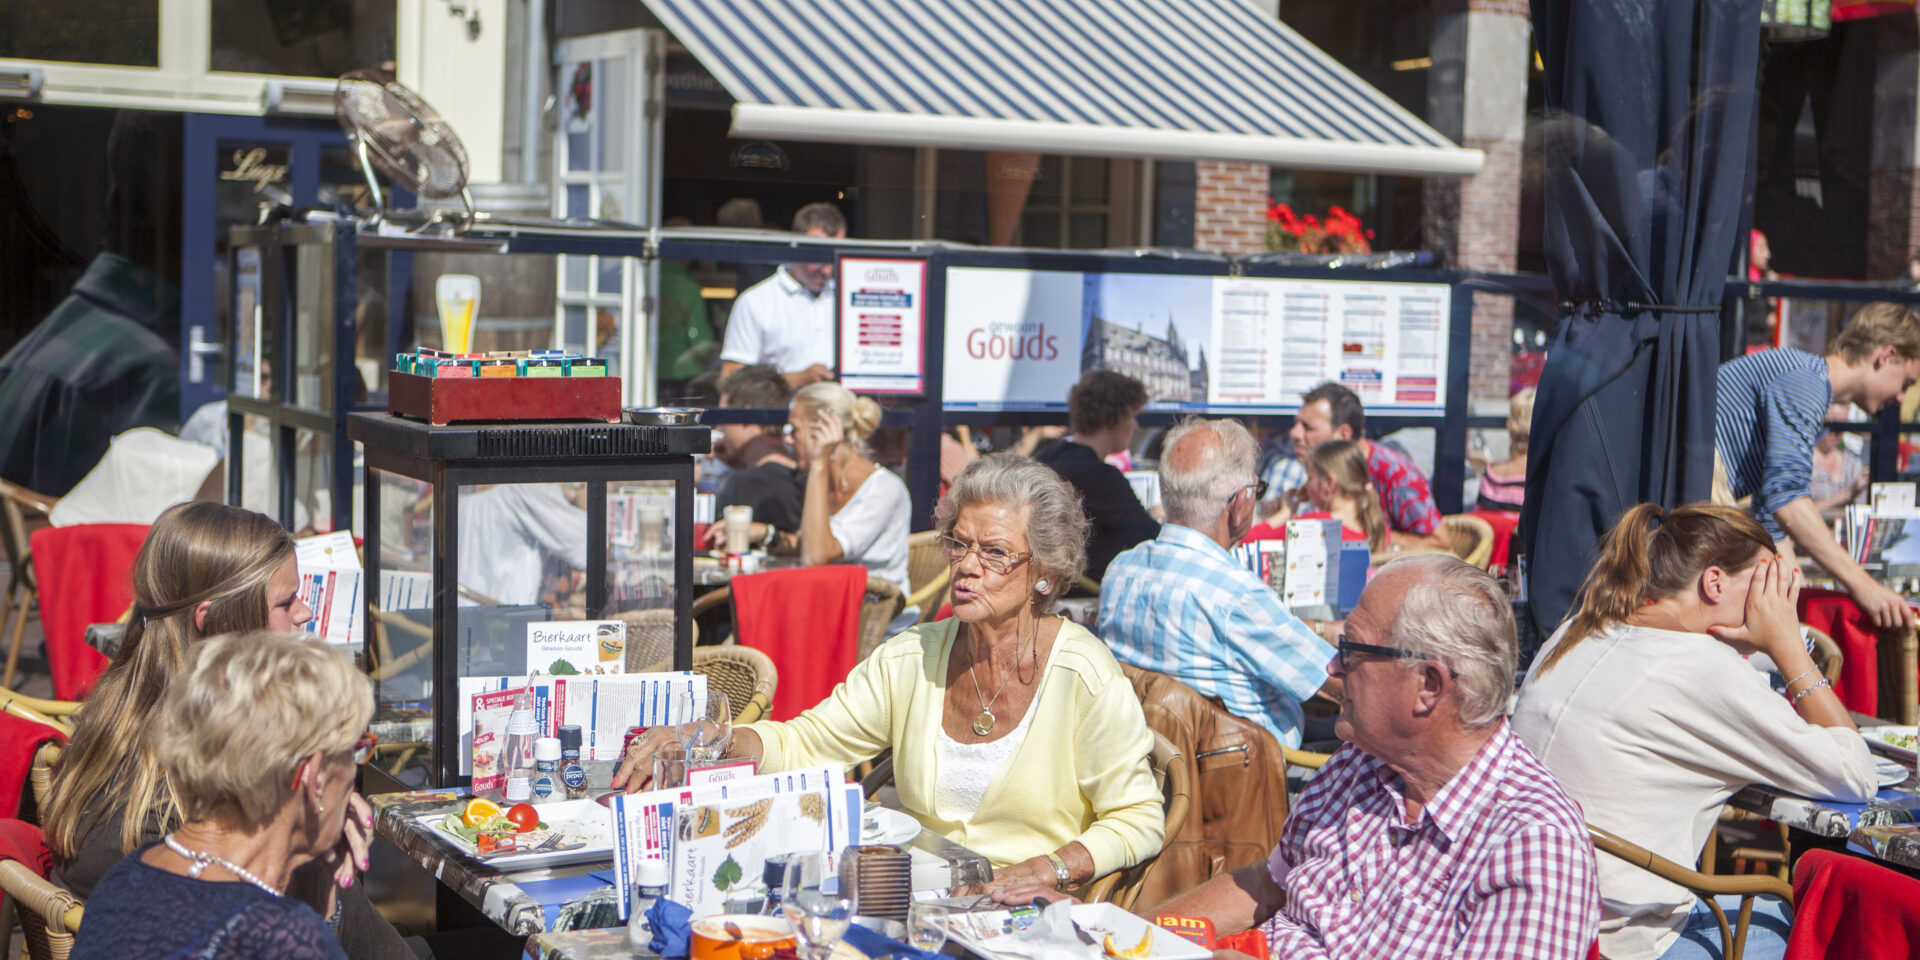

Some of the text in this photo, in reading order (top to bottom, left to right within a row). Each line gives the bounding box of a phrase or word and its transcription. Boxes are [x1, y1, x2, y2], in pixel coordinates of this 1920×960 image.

[967, 322, 1059, 361] Gouds
[533, 630, 592, 643] Bierkaart
[475, 697, 487, 713] &
[709, 771, 736, 783] Gouds
[473, 778, 495, 793] Gouds
